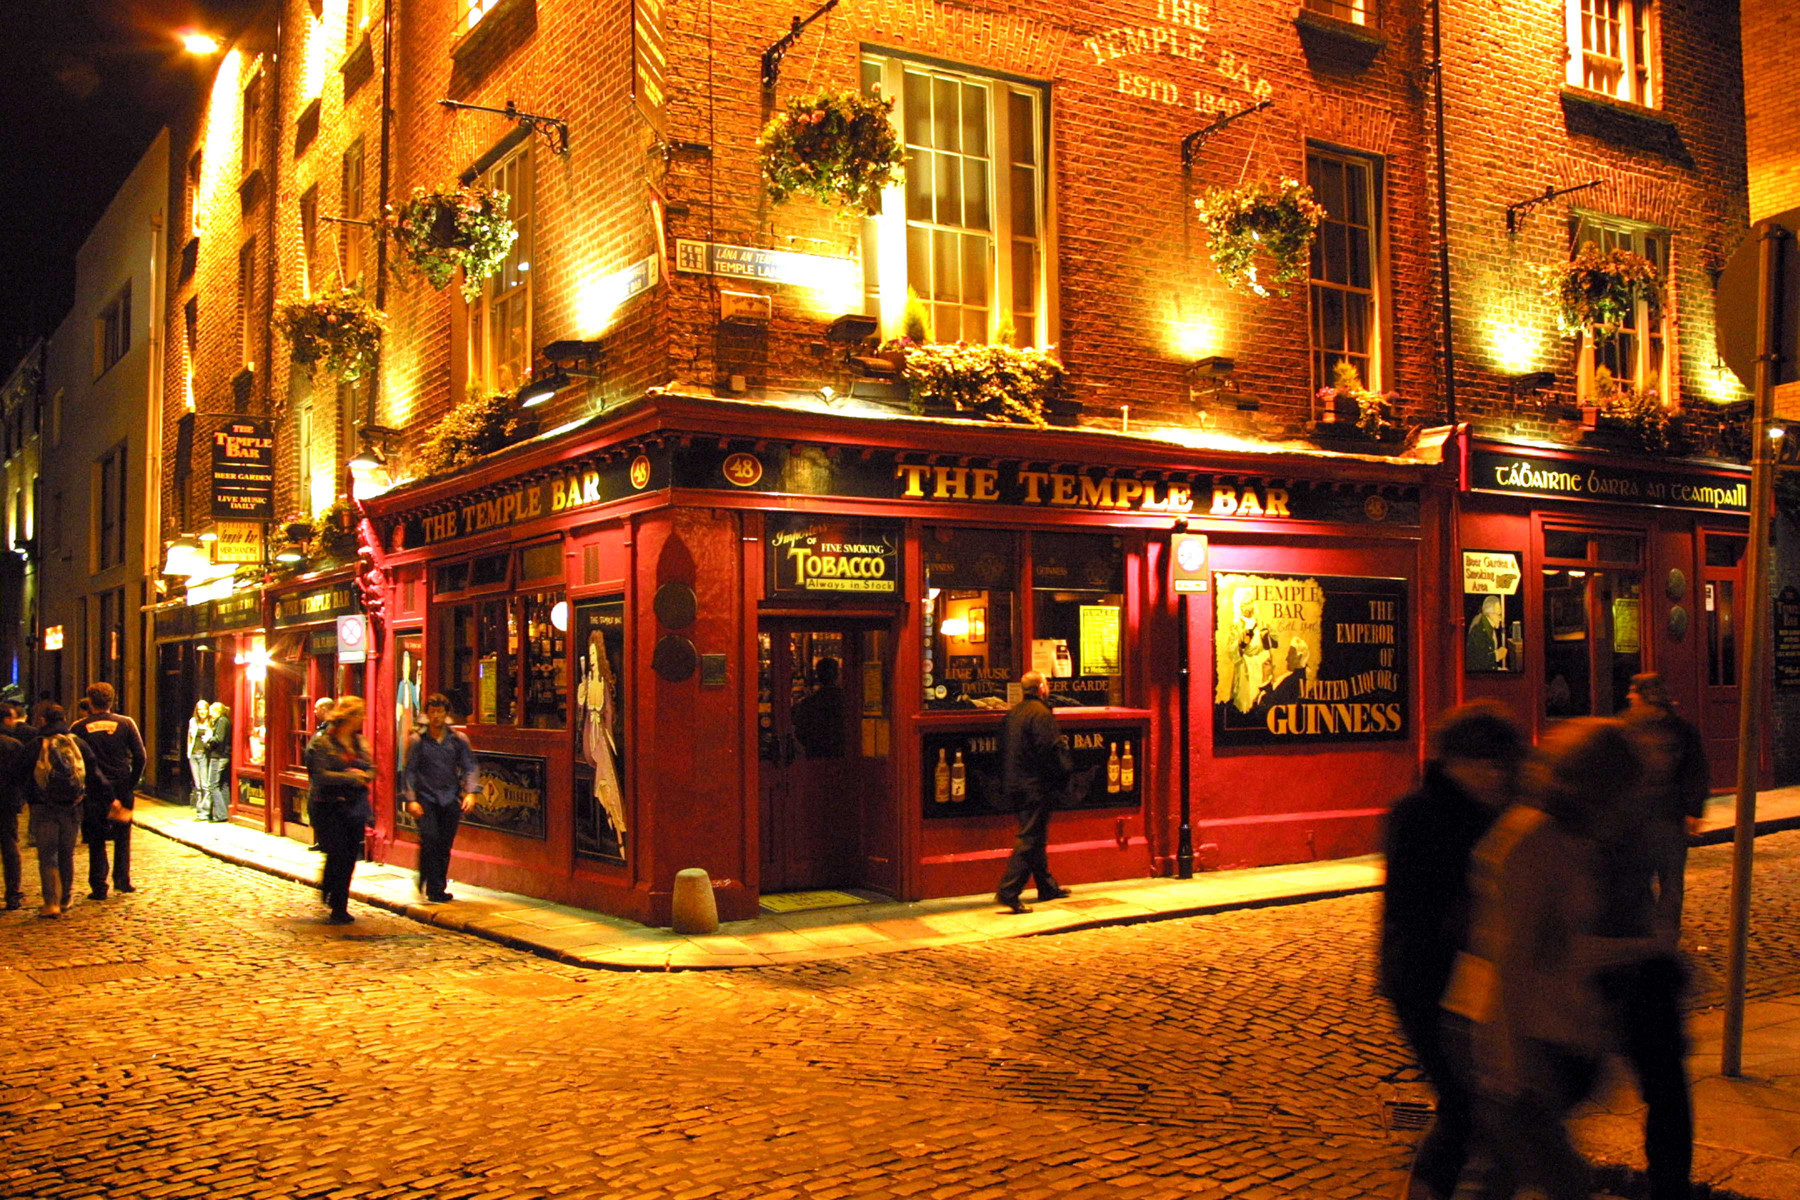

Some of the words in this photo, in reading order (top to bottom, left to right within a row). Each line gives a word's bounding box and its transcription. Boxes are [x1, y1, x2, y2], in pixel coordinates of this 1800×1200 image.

[1157, 0, 1210, 31] THE
[1083, 26, 1206, 65] TEMPLE
[1216, 50, 1273, 110] BAR
[1193, 91, 1241, 115] 1840
[740, 251, 753, 262] AN
[714, 260, 754, 275] TEMPLE
[232, 424, 254, 434] THE
[213, 431, 272, 448] TEMPLE
[226, 444, 260, 459] BAR
[634, 462, 647, 482] 48
[730, 458, 754, 478] 48
[897, 464, 1000, 501] THE
[1018, 470, 1195, 513] TEMPLE
[1209, 484, 1291, 518] BAR
[423, 510, 458, 544] THE
[462, 486, 542, 533] TEMPLE
[551, 470, 602, 512] BAR
[806, 537, 817, 545] OF
[821, 543, 843, 553] FINE
[843, 543, 885, 554] SMOKING
[787, 548, 885, 585] TOBACCO
[1465, 555, 1481, 567] Beer
[1483, 556, 1509, 569] Garden
[1465, 568, 1495, 582] Smoking
[807, 579, 845, 589] Always
[850, 579, 860, 588] in
[863, 580, 893, 590] Stock
[1471, 581, 1489, 592] Area
[1253, 585, 1321, 602] TEMPLE
[301, 593, 331, 614] TEMPLE
[1273, 602, 1306, 621] BAR
[1369, 600, 1394, 621] THE
[1336, 623, 1394, 645] EMPEROR
[1380, 648, 1395, 668] OF
[945, 668, 975, 680] LIVE
[977, 668, 1012, 680] MUSIC
[962, 681, 993, 694] DAILY
[1047, 680, 1069, 693] EER
[1072, 680, 1109, 693] GARDE
[1298, 678, 1349, 701] MALTED
[1350, 669, 1400, 698] LIQUORS
[1266, 702, 1402, 735] GUINNESS
[1073, 732, 1104, 749] BAR
